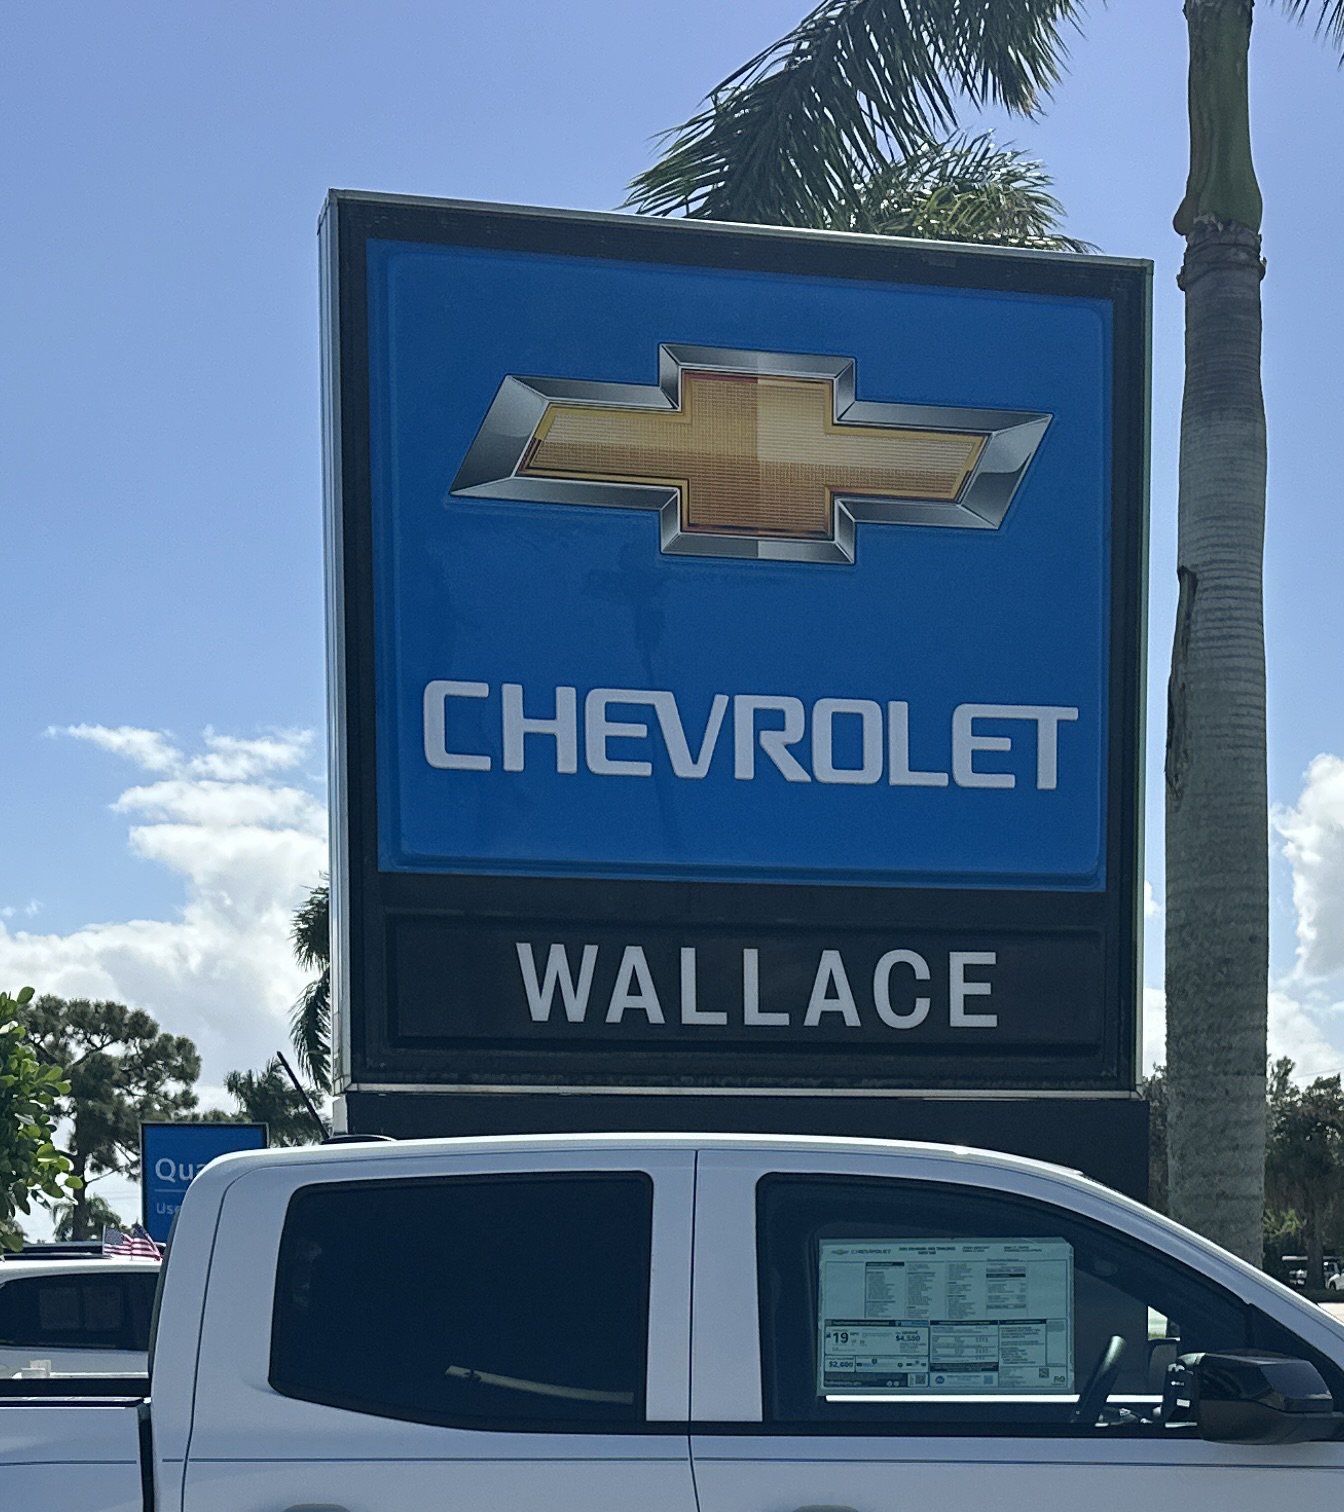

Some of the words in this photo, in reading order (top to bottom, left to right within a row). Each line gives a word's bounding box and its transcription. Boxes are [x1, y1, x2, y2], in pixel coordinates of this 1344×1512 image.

[423, 679, 1079, 790] CHEVROLET
[516, 942, 998, 1029] WALLACE
[833, 1332, 849, 1343] 19
